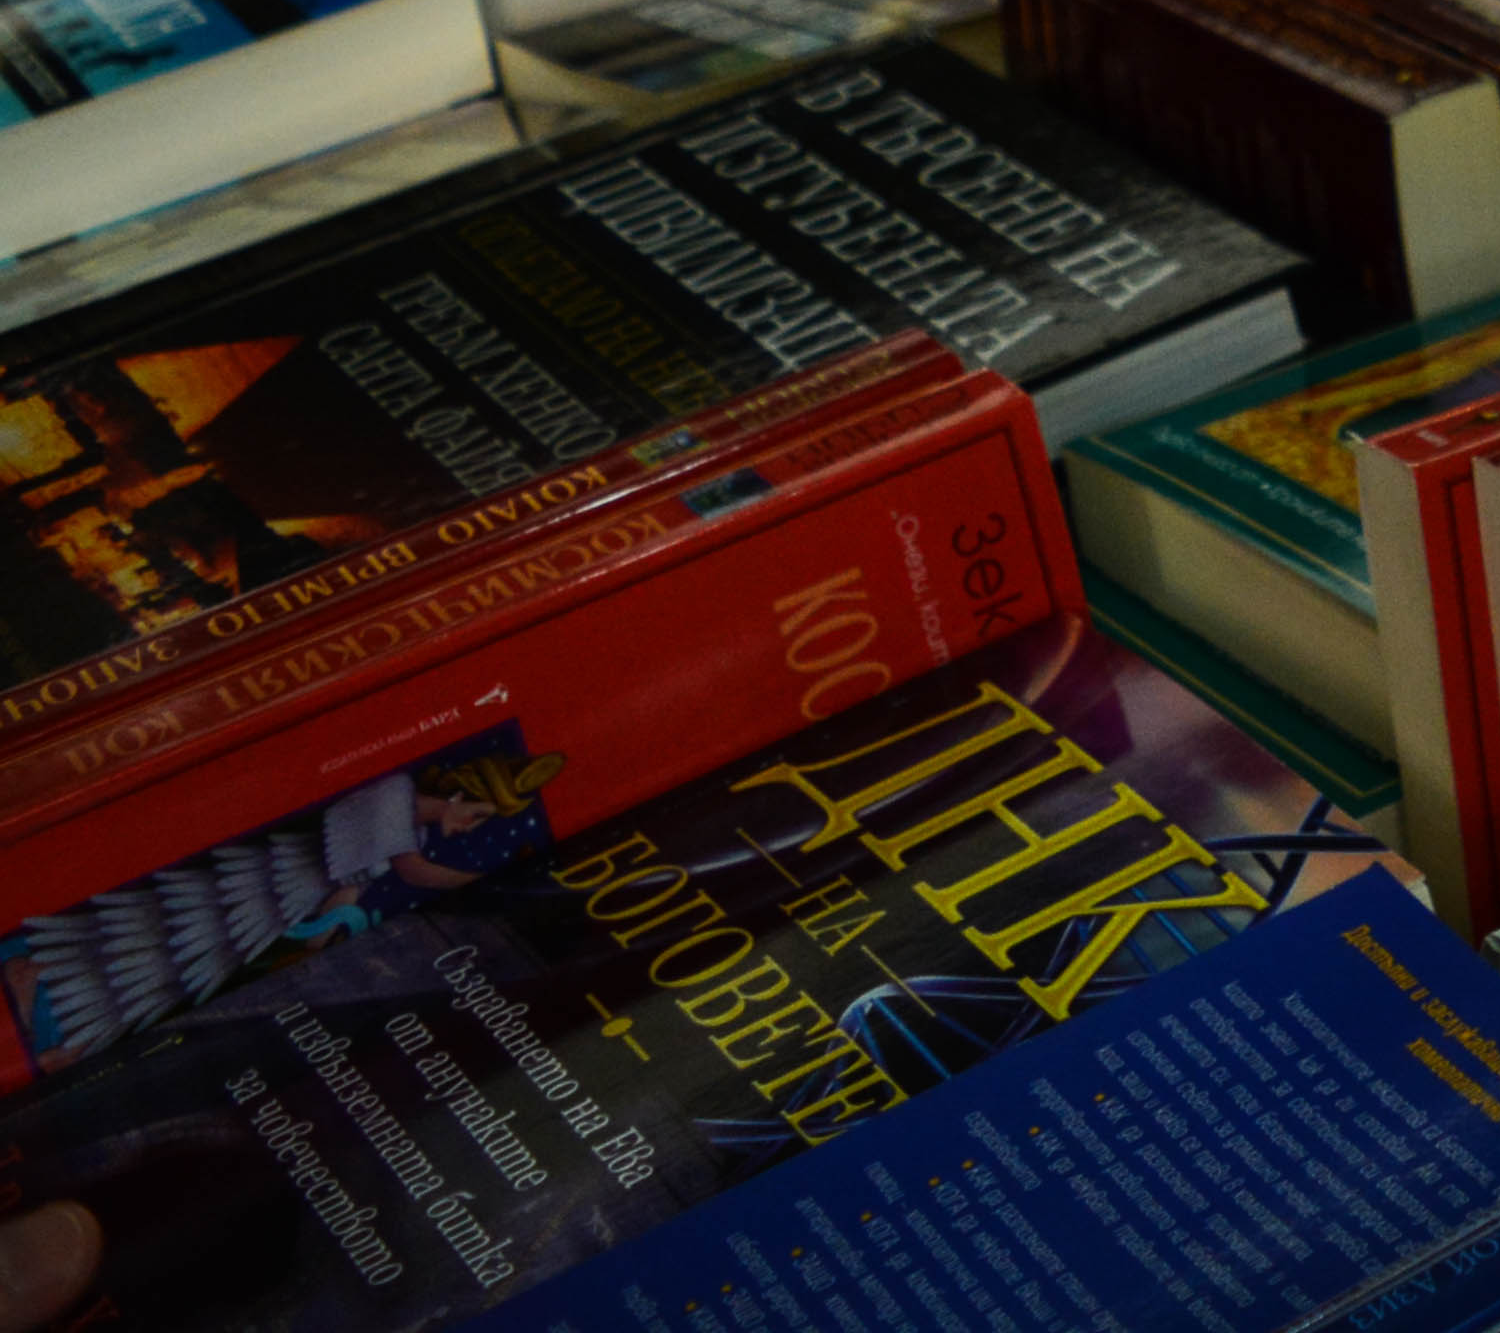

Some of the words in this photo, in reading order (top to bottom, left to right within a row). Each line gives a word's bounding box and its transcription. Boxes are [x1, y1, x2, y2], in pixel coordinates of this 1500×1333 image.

[557, 156, 882, 381] ЦИВИЛИЗАЦ
[673, 118, 1058, 366] ИЗГУБЕНАТА
[851, 93, 1092, 247] ТЪРСЕНЕ
[1061, 227, 1186, 314] НА
[319, 322, 421, 408] САНТА
[208, 537, 421, 640] ВРЕМЕТО
[214, 512, 668, 719] КОСМИЧЕСКИЯТ
[771, 565, 895, 723] КОС
[952, 510, 1015, 634] Зек
[0, 634, 182, 721] ЗАПОЧ
[64, 702, 186, 778] КОД
[730, 679, 1271, 1023] ДНК
[778, 872, 889, 957] НА
[432, 944, 579, 1104] Създаването
[559, 1095, 610, 1141] на
[599, 1125, 655, 1191] Ева
[551, 830, 911, 1149] БОГОВЕТЕ
[223, 1065, 258, 1103] за
[249, 1092, 406, 1289] човечеството
[274, 1000, 294, 1025] и
[292, 1013, 445, 1201] извънземната
[426, 1191, 516, 1289] битка
[382, 1012, 425, 1059] от
[414, 1049, 549, 1193] анунаките
